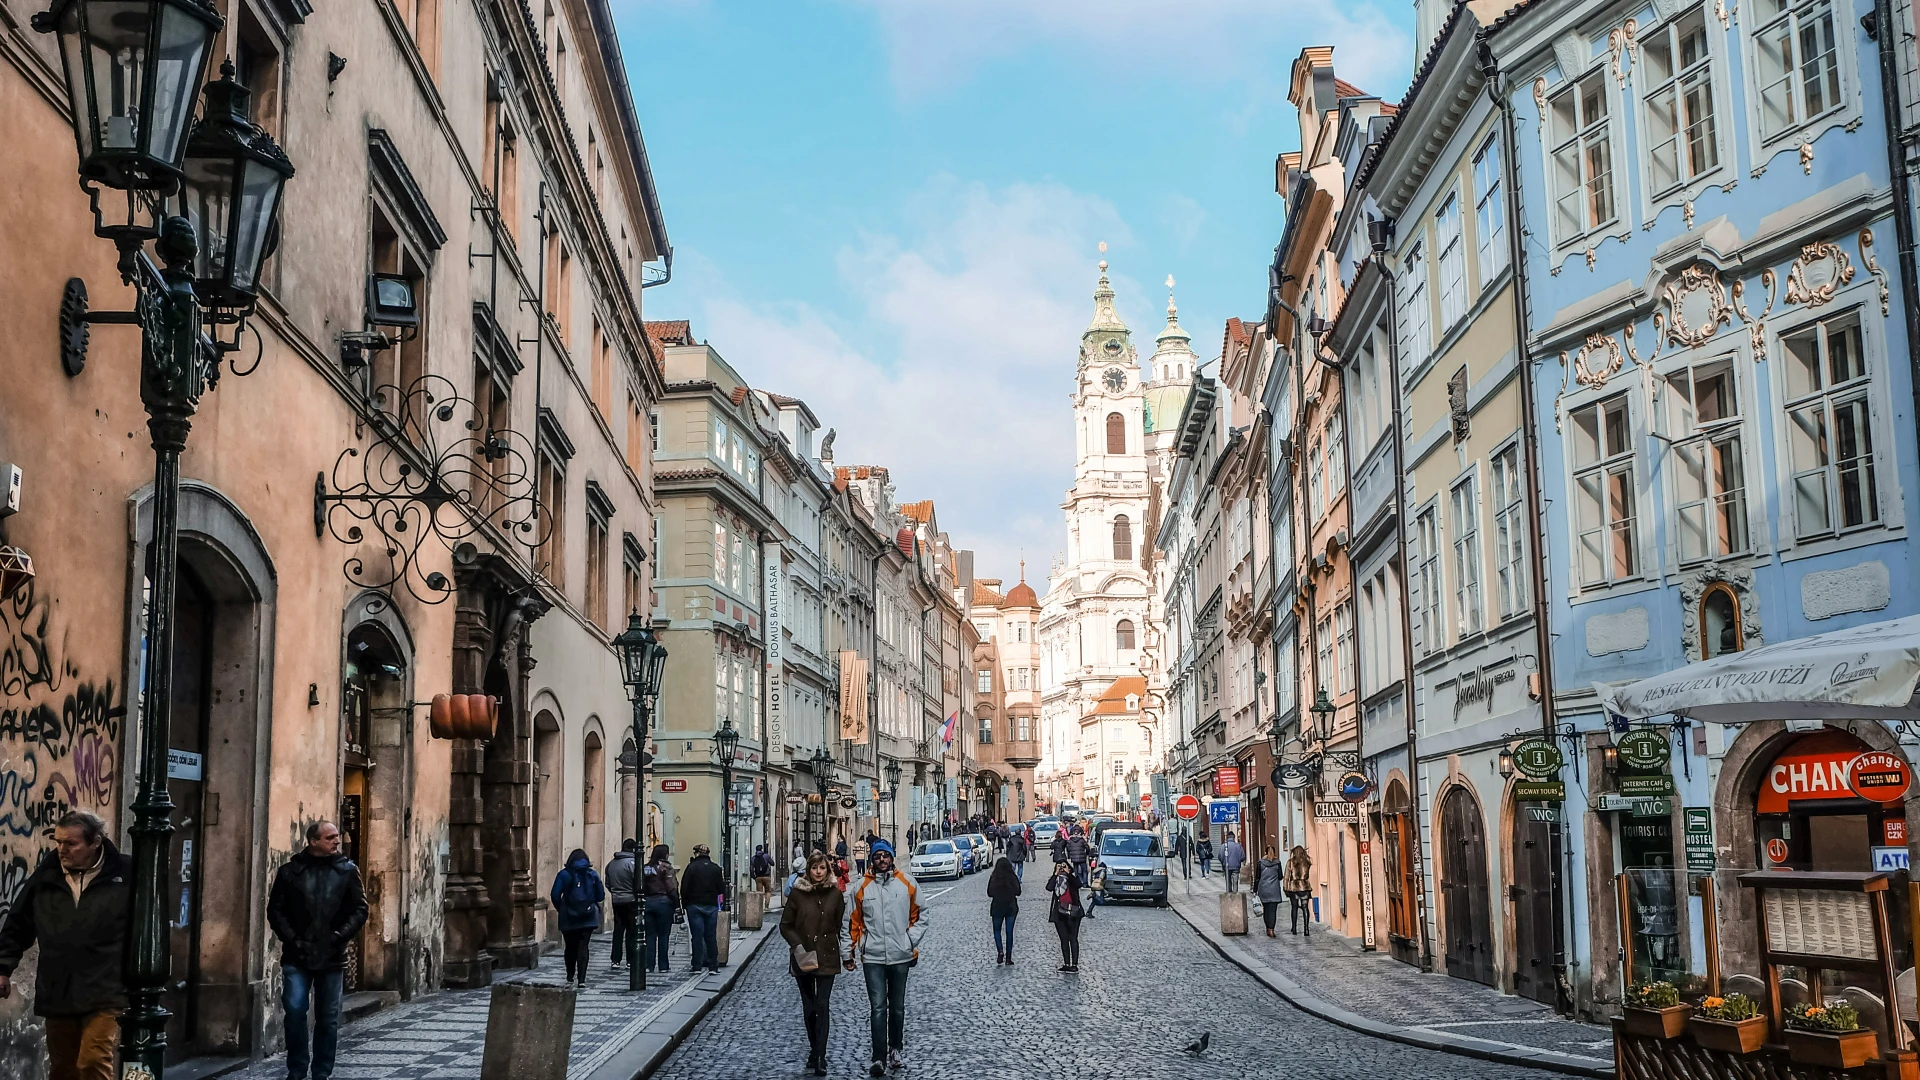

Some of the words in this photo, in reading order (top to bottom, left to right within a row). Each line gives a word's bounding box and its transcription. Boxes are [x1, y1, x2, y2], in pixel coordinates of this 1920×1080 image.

[769, 565, 778, 618] BALTHASAR
[770, 620, 779, 658] DOMUS
[771, 673, 780, 711] HOTEL
[1453, 665, 1494, 722] Jewellery
[1641, 673, 1737, 703] RESTAURANT
[1731, 670, 1768, 687] POD
[771, 715, 780, 753] DESIGN
[1622, 731, 1648, 745] TOURIST
[1649, 732, 1664, 745] INFO
[1518, 742, 1542, 754] TOURIST
[1543, 743, 1557, 754] INFO
[1856, 755, 1901, 771] change
[1315, 802, 1356, 817] CHANGE
[1532, 809, 1554, 821] WC
[1639, 801, 1664, 815] WC
[1622, 825, 1655, 837] TOURIST
[1887, 831, 1903, 839] CZK
[1685, 834, 1713, 845] HOSTEL
[1363, 855, 1371, 912] COMMISSION
